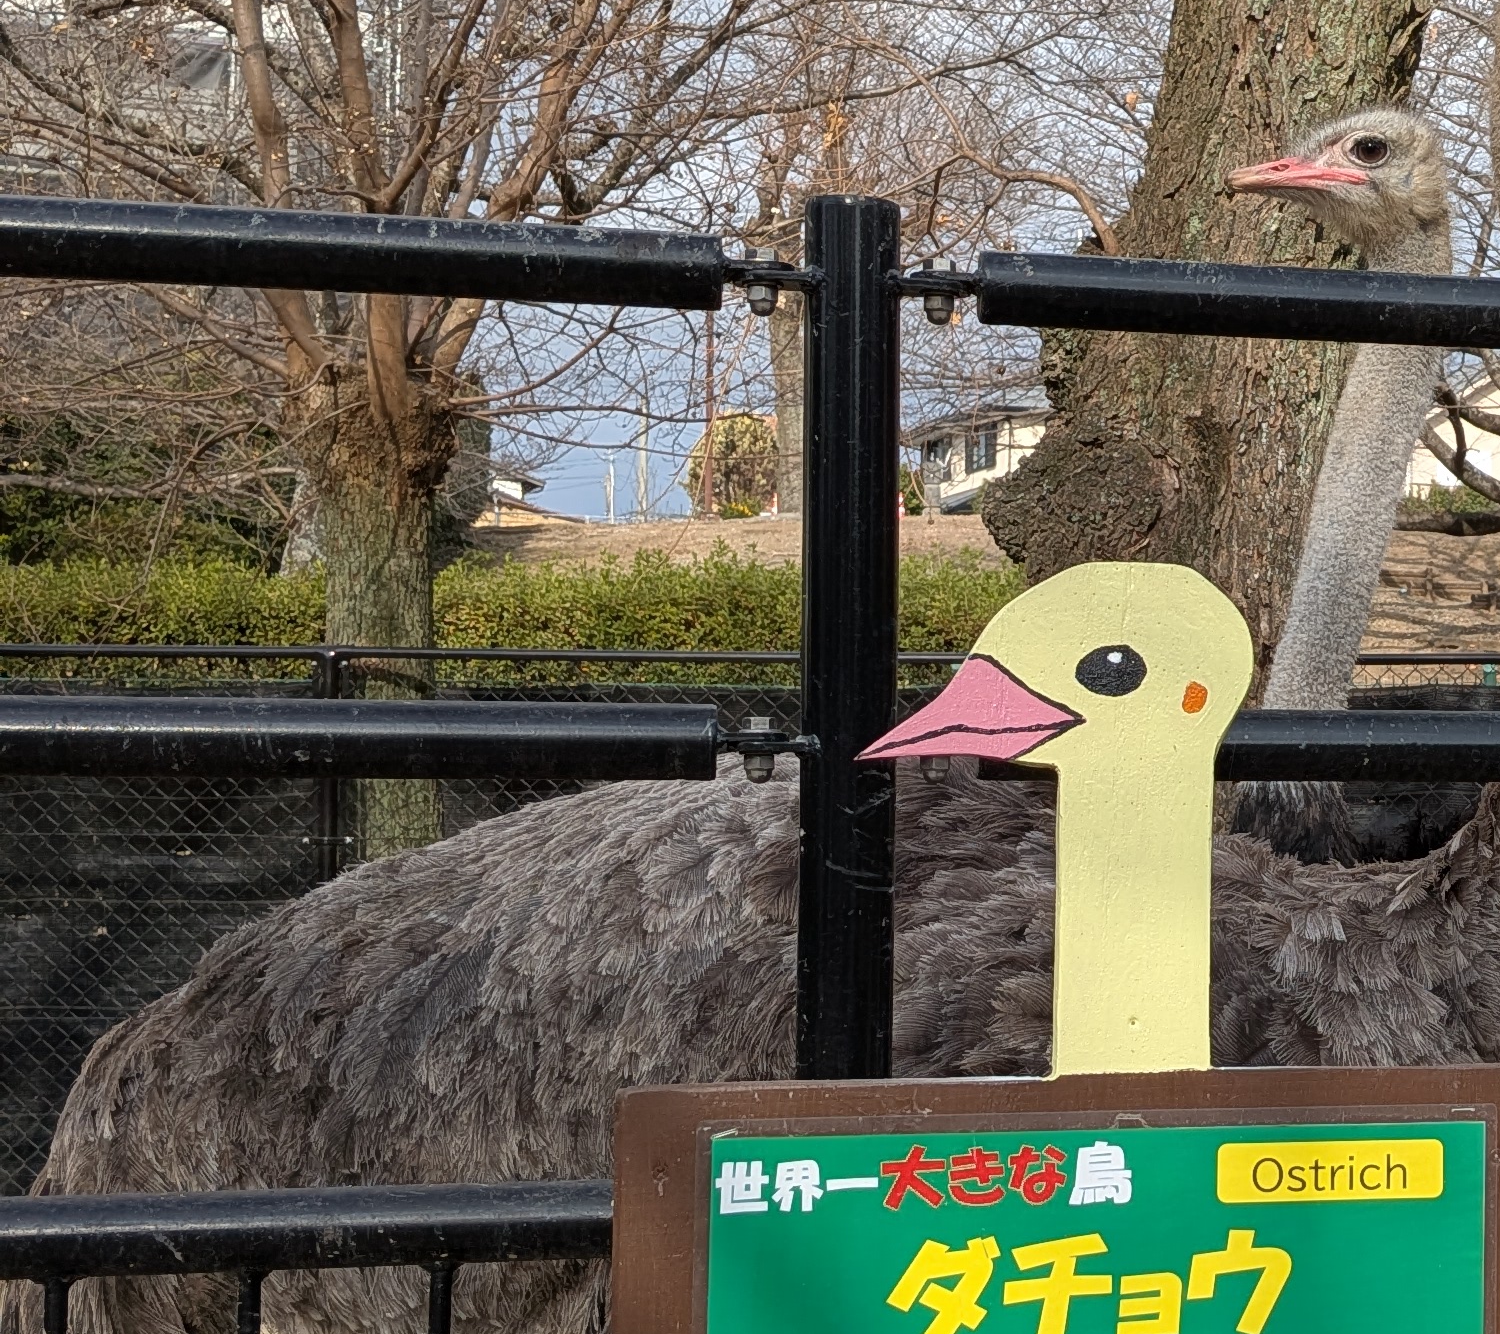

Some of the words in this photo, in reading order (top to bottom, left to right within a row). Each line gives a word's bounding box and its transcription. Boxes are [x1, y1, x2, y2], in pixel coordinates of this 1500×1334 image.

[714, 1140, 1132, 1215] 世界一大きな鳥
[1252, 1154, 1408, 1193] Ostrich
